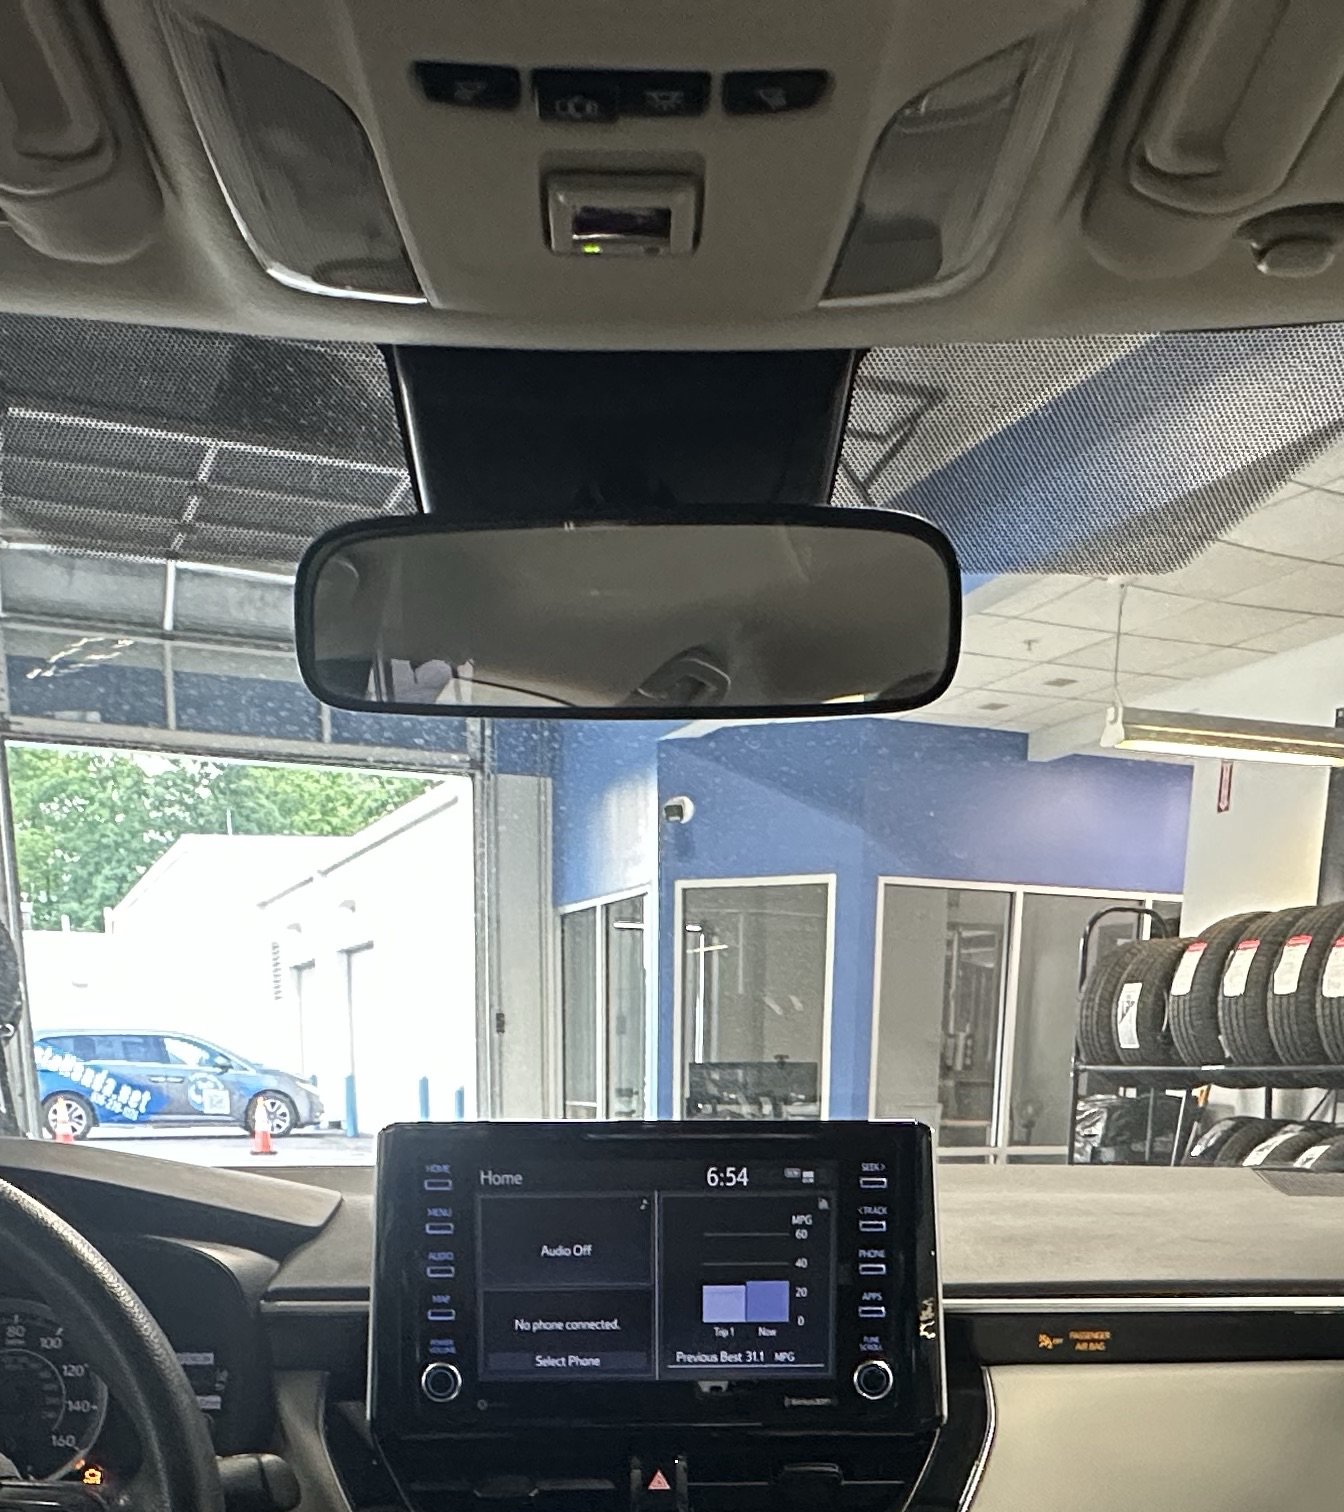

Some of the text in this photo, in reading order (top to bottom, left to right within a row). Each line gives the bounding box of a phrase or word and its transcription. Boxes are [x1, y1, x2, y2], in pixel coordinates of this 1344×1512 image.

[480, 1170, 523, 1185] Home
[706, 1166, 749, 1187] 6:54
[791, 1214, 813, 1226] MPG
[795, 1229, 808, 1240] 60
[428, 1252, 454, 1261] AUDIO
[540, 1244, 593, 1257] Audio Off
[858, 1249, 886, 1258] PHONE
[795, 1258, 808, 1268] 40
[795, 1287, 808, 1298] 20
[514, 1318, 621, 1333] No phone connected.
[797, 1316, 805, 1326] 0
[6, 1325, 26, 1338] 80
[713, 1327, 729, 1338] Trip
[758, 1327, 777, 1337] Now
[40, 1337, 63, 1349] 100
[535, 1355, 601, 1367] Select Phone
[676, 1351, 795, 1362] Previous Best 31.1 MPG
[62, 1364, 85, 1377] 120
[67, 1400, 90, 1412] 140
[51, 1435, 76, 1447] 160
